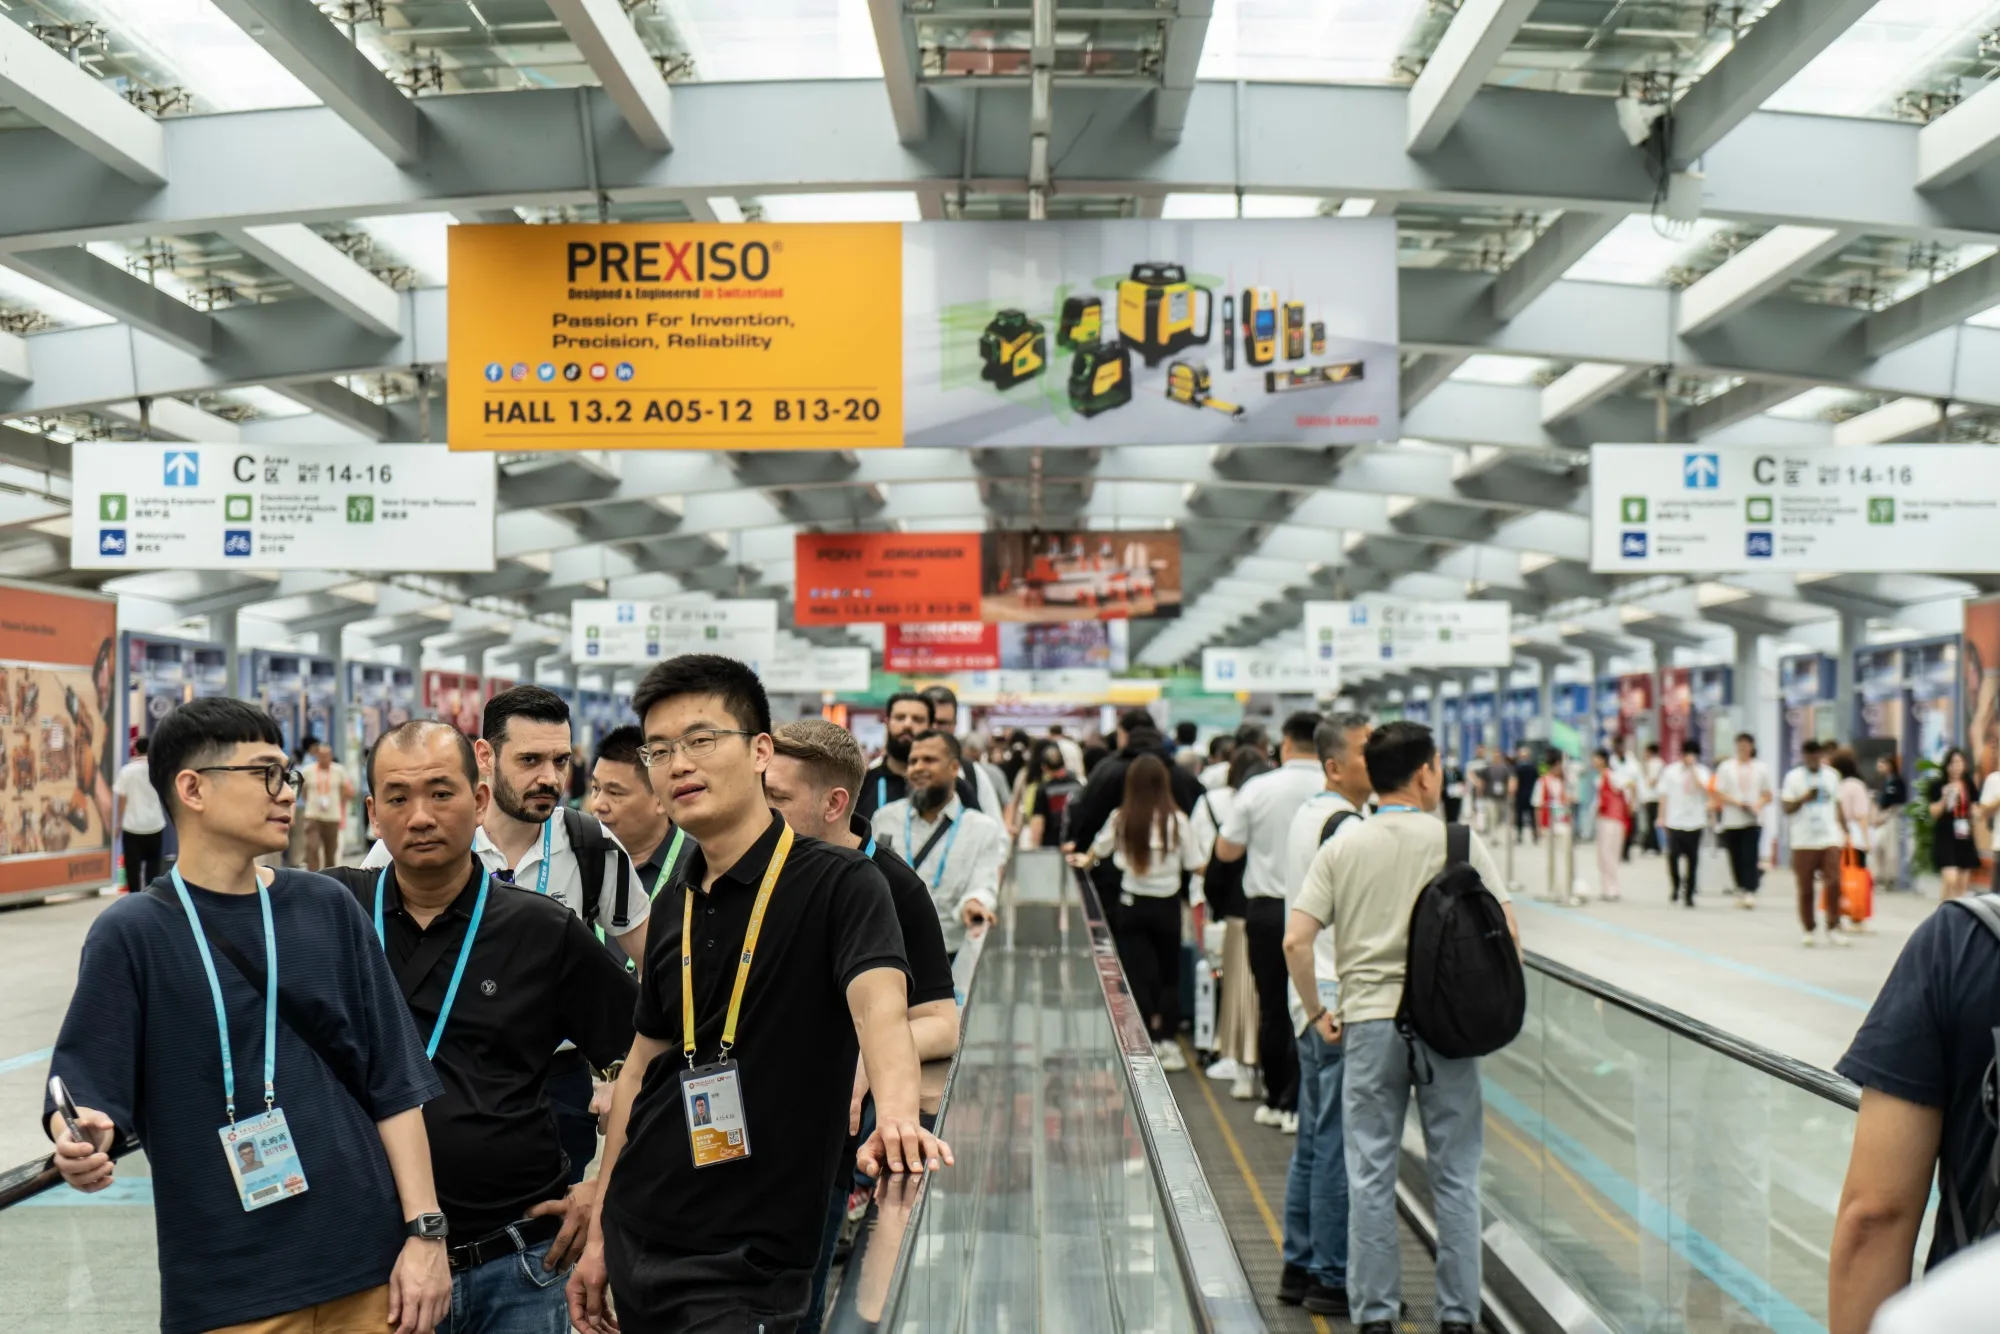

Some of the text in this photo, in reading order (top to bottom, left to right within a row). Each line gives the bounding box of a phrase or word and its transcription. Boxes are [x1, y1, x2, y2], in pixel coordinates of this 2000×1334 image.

[567, 242, 770, 282] PREXISO
[568, 287, 622, 300] Designed
[636, 287, 699, 301] Engineered
[553, 312, 795, 330] Passion For Invention,
[553, 333, 772, 351] Precision, Reliability
[484, 398, 880, 423] HALL 13.2 A05-12 B13-20
[233, 455, 256, 482] C
[264, 468, 281, 483] 区
[327, 464, 392, 483] 14-16
[1753, 455, 1777, 485] C
[1848, 465, 1913, 485] 14-16
[261, 1132, 287, 1148] 采购商
[264, 1144, 289, 1156] BUYER
